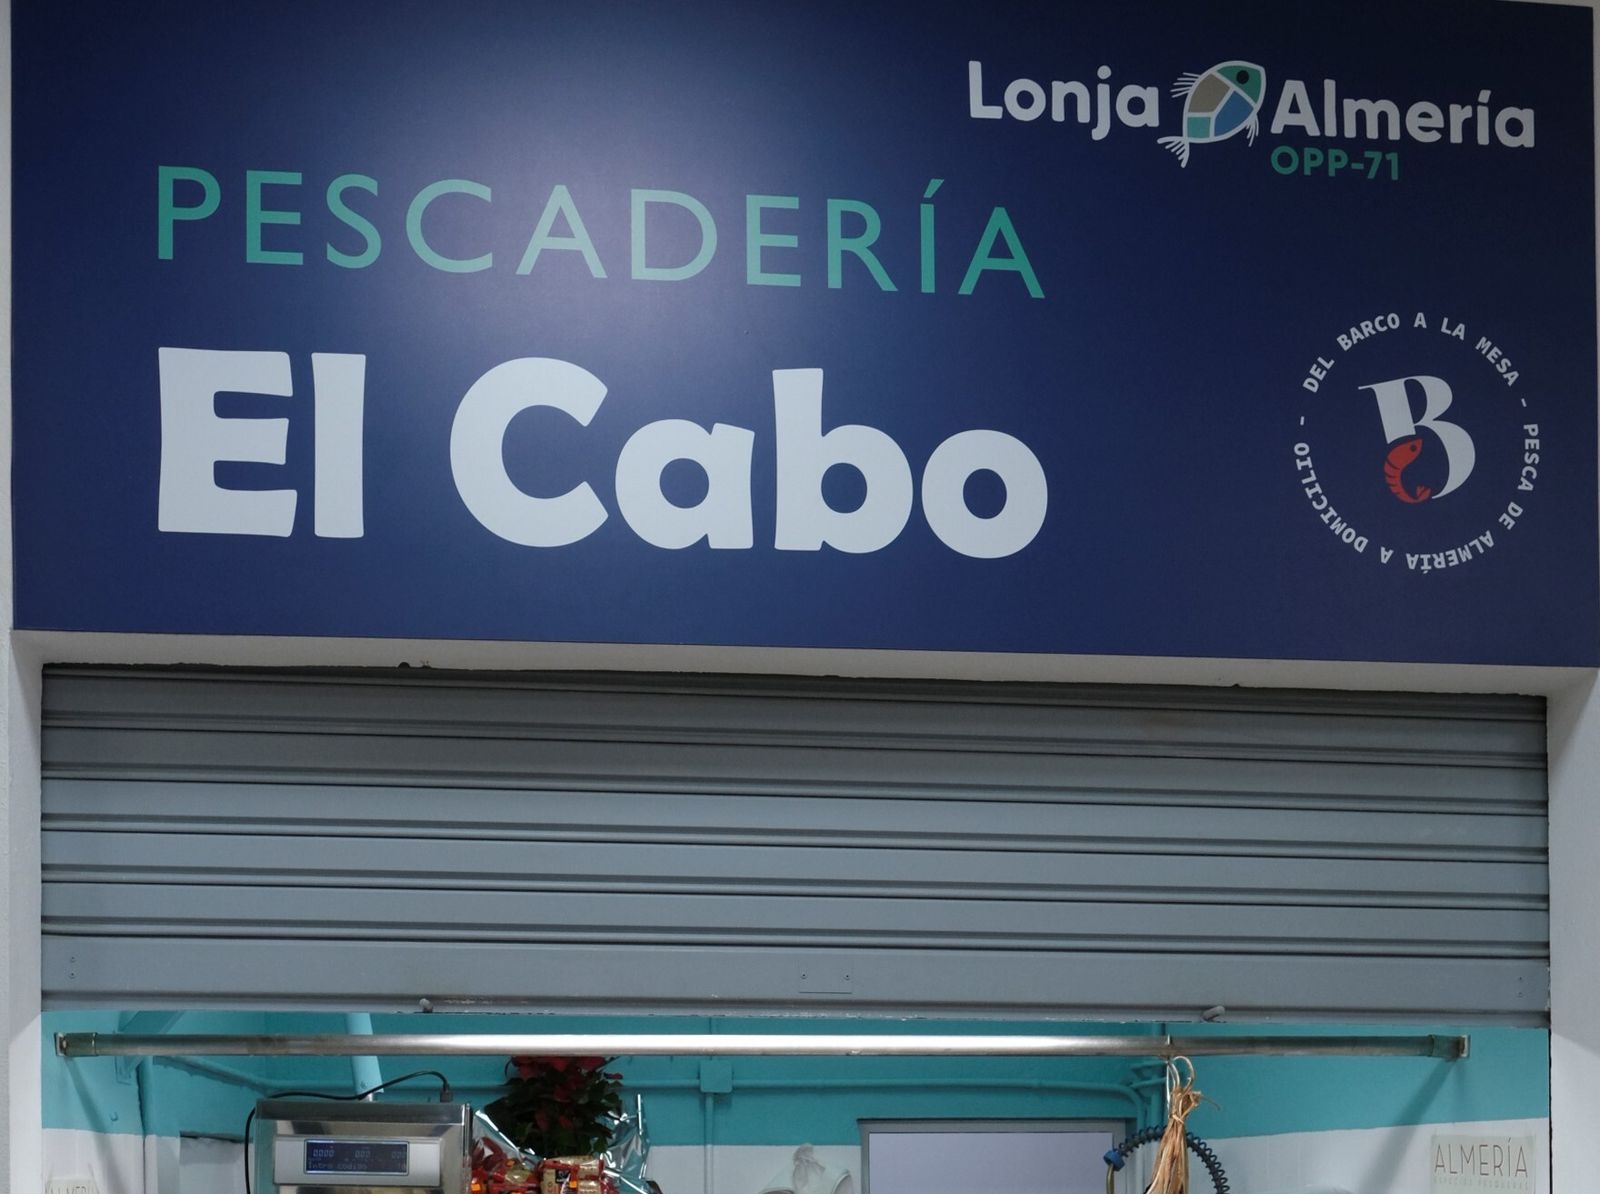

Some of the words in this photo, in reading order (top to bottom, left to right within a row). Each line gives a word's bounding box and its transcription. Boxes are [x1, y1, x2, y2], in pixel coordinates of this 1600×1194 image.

[968, 60, 1160, 141] Lonja
[1270, 78, 1536, 148] Almería
[1270, 145, 1400, 180] OPP-71
[156, 164, 1047, 300] PESCADERÍA
[1302, 356, 1335, 393] DEL
[1336, 312, 1401, 352] BARCO
[1413, 312, 1428, 329] A
[1440, 317, 1466, 341] LA
[1475, 336, 1520, 388] MESA
[158, 346, 367, 541] El
[450, 357, 1049, 560] Cabo
[1517, 423, 1541, 492] PESCA
[1293, 442, 1369, 553] DOMICILIO
[1498, 501, 1524, 530] DE
[1379, 546, 1394, 565] A
[1405, 530, 1496, 575] ALMERÍA
[1434, 1137, 1528, 1178] ALMERÍA
